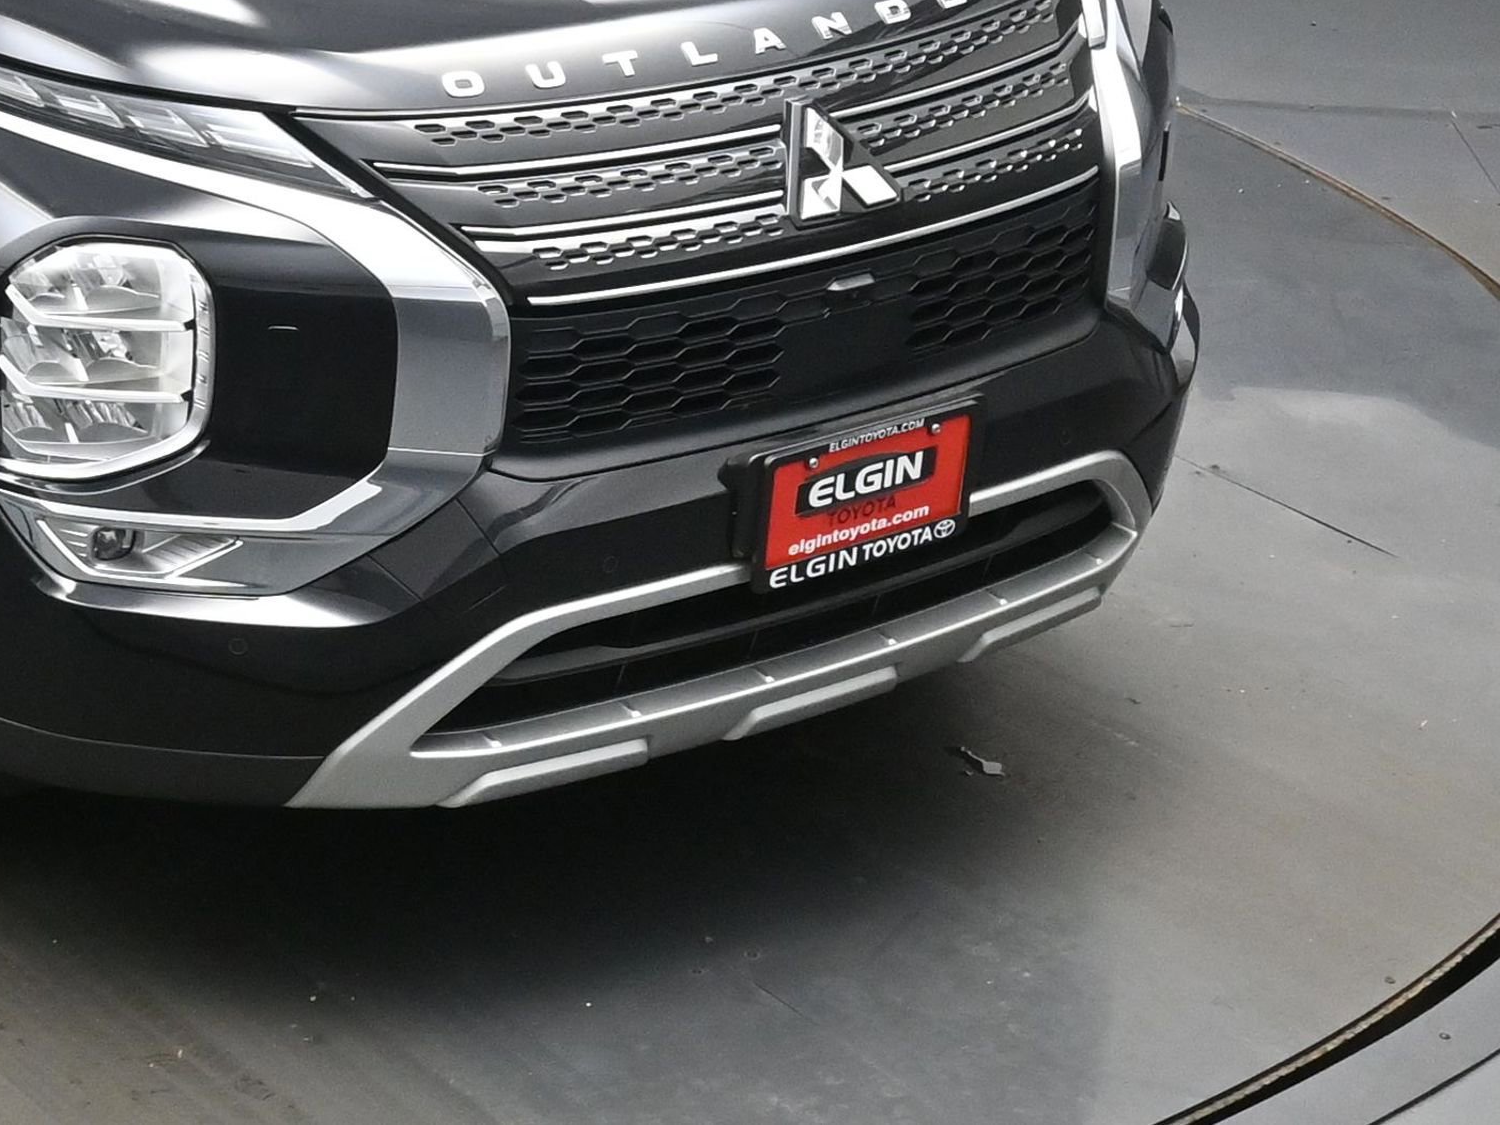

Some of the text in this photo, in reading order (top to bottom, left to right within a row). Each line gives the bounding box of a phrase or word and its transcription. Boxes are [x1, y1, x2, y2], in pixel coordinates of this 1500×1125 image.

[828, 418, 926, 453] ELGINTOYOTA.COM
[808, 451, 924, 508] ELGIN
[788, 505, 930, 556] elgintoyota.com
[827, 495, 897, 527] TOYOTA
[769, 530, 933, 589] ELGIN TOYOTA
